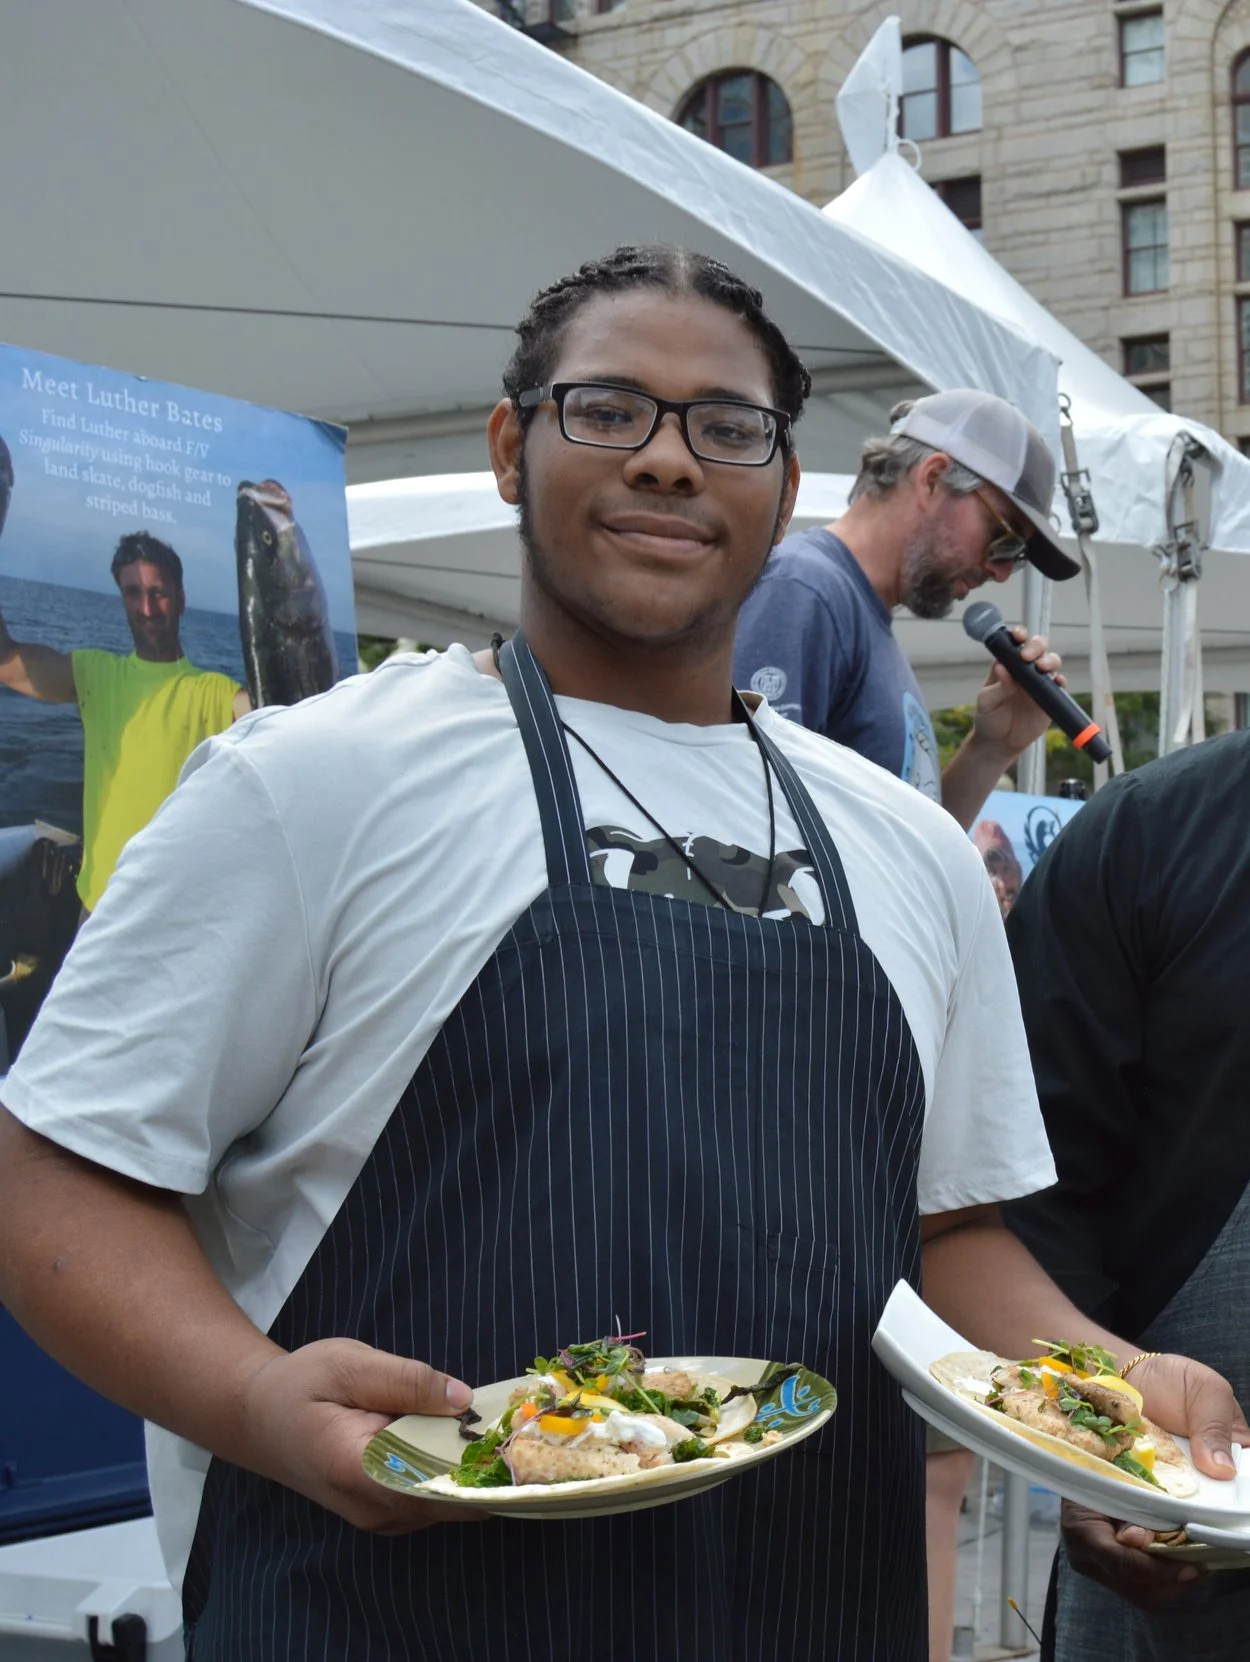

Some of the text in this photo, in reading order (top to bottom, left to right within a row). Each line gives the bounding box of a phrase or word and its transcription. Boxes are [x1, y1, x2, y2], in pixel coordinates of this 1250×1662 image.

[22, 367, 223, 433] Meet Luther Bates
[19, 429, 232, 487] Singularity using hook gear to
[42, 408, 210, 459] Find Luther aboard F/V
[44, 456, 211, 507] land skate, dogfish and
[86, 494, 177, 524] striped bass.
